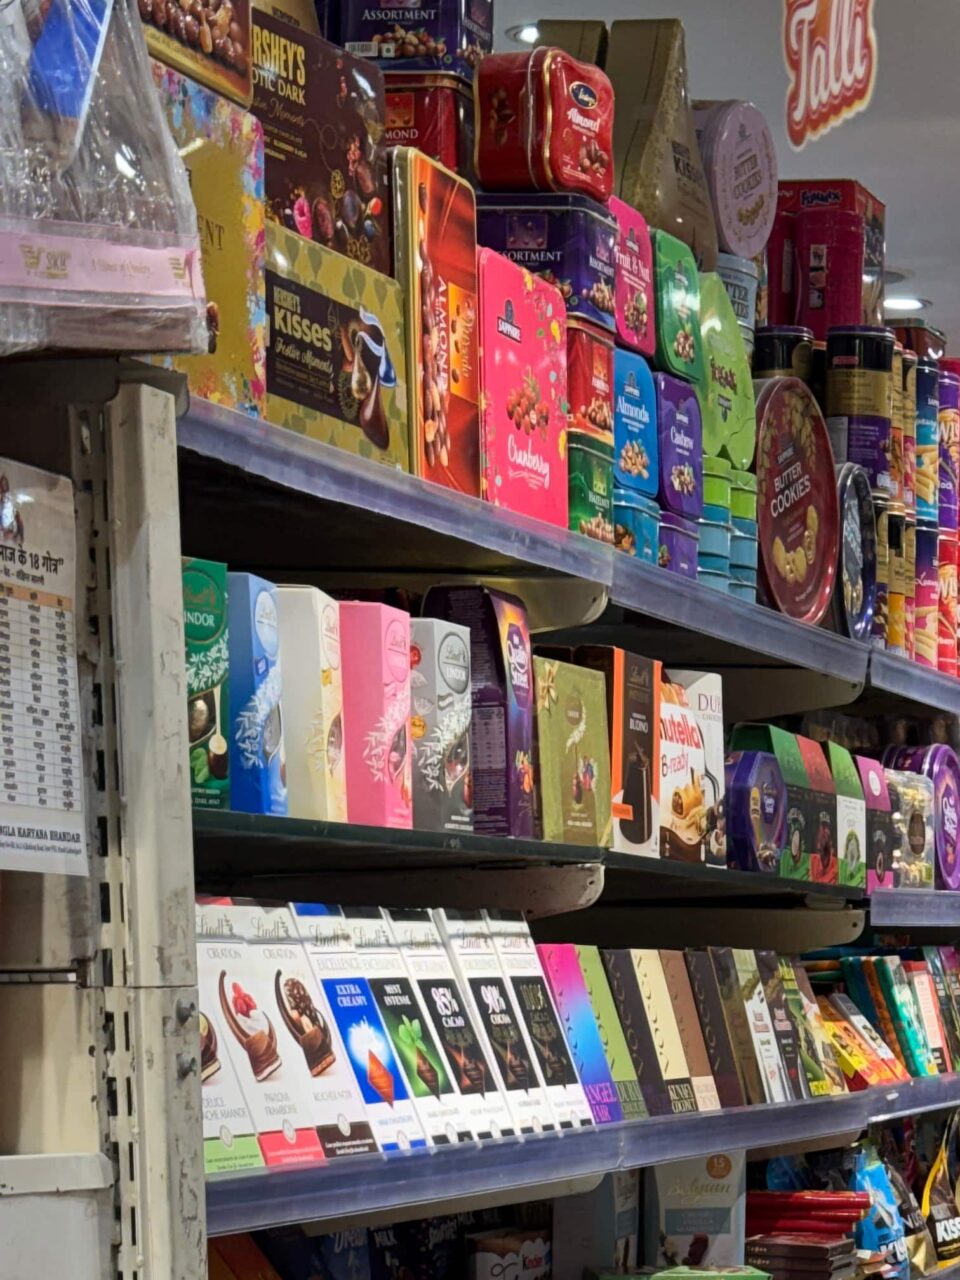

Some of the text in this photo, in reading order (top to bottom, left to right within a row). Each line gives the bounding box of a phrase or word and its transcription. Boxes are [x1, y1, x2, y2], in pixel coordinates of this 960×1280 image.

[362, 9, 436, 21] ASSORTMENT
[252, 22, 305, 87] RSHEY'S
[791, 0, 866, 121] Talli
[277, 78, 306, 106] DARK
[385, 128, 419, 140] MOND
[496, 250, 563, 263] SORTMENT
[273, 305, 332, 352] KISSES
[616, 394, 650, 424] Almonds
[506, 434, 551, 487] Cranberry
[773, 461, 803, 493] BUTTER
[770, 474, 811, 518] COOKIES
[29, 552, 40, 570] 18
[660, 713, 702, 750] nutella
[250, 916, 285, 938] Lindt
[336, 984, 361, 995] EXTRA
[337, 996, 367, 1008] CREAMY
[481, 985, 505, 1014] 90%
[713, 1157, 725, 1167] 15
